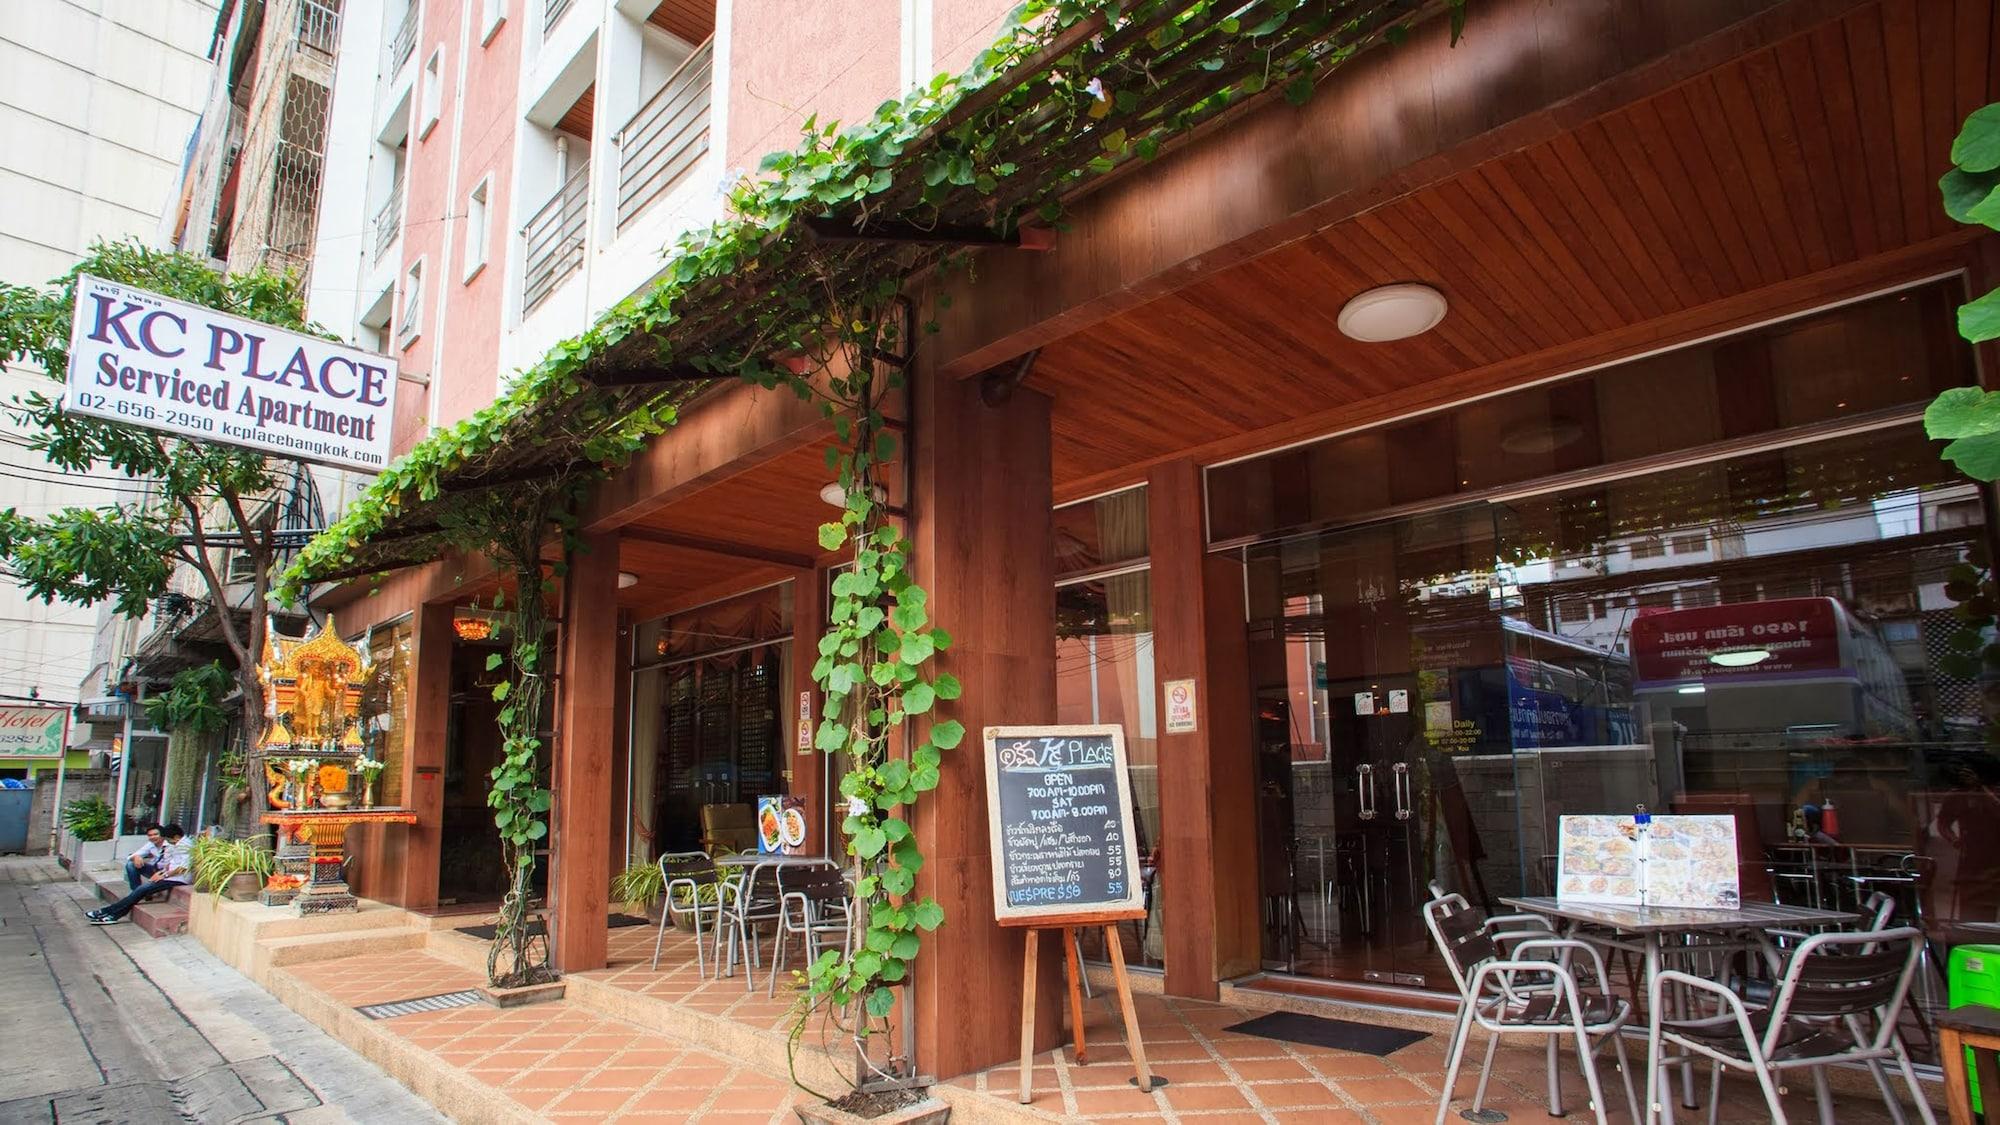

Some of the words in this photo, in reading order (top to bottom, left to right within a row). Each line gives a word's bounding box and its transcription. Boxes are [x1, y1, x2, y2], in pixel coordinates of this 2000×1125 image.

[87, 293, 187, 358] KC
[204, 323, 388, 407] PLACE
[96, 352, 230, 411] Serviced
[236, 386, 376, 441] Apartment
[79, 392, 214, 432] 02-656-2950
[223, 422, 383, 465] kcplacebangkok.com
[1454, 720, 1475, 729] Daily
[1069, 739, 1113, 766] PLACE
[1044, 773, 1073, 786] OPEN
[1052, 797, 1074, 809] SAT
[1105, 832, 1119, 842] 40
[1107, 845, 1122, 855] 55
[1108, 856, 1122, 866] 55
[1107, 868, 1122, 879] 80
[1008, 885, 1081, 902] NESPRESSO
[1107, 881, 1123, 894] 55
